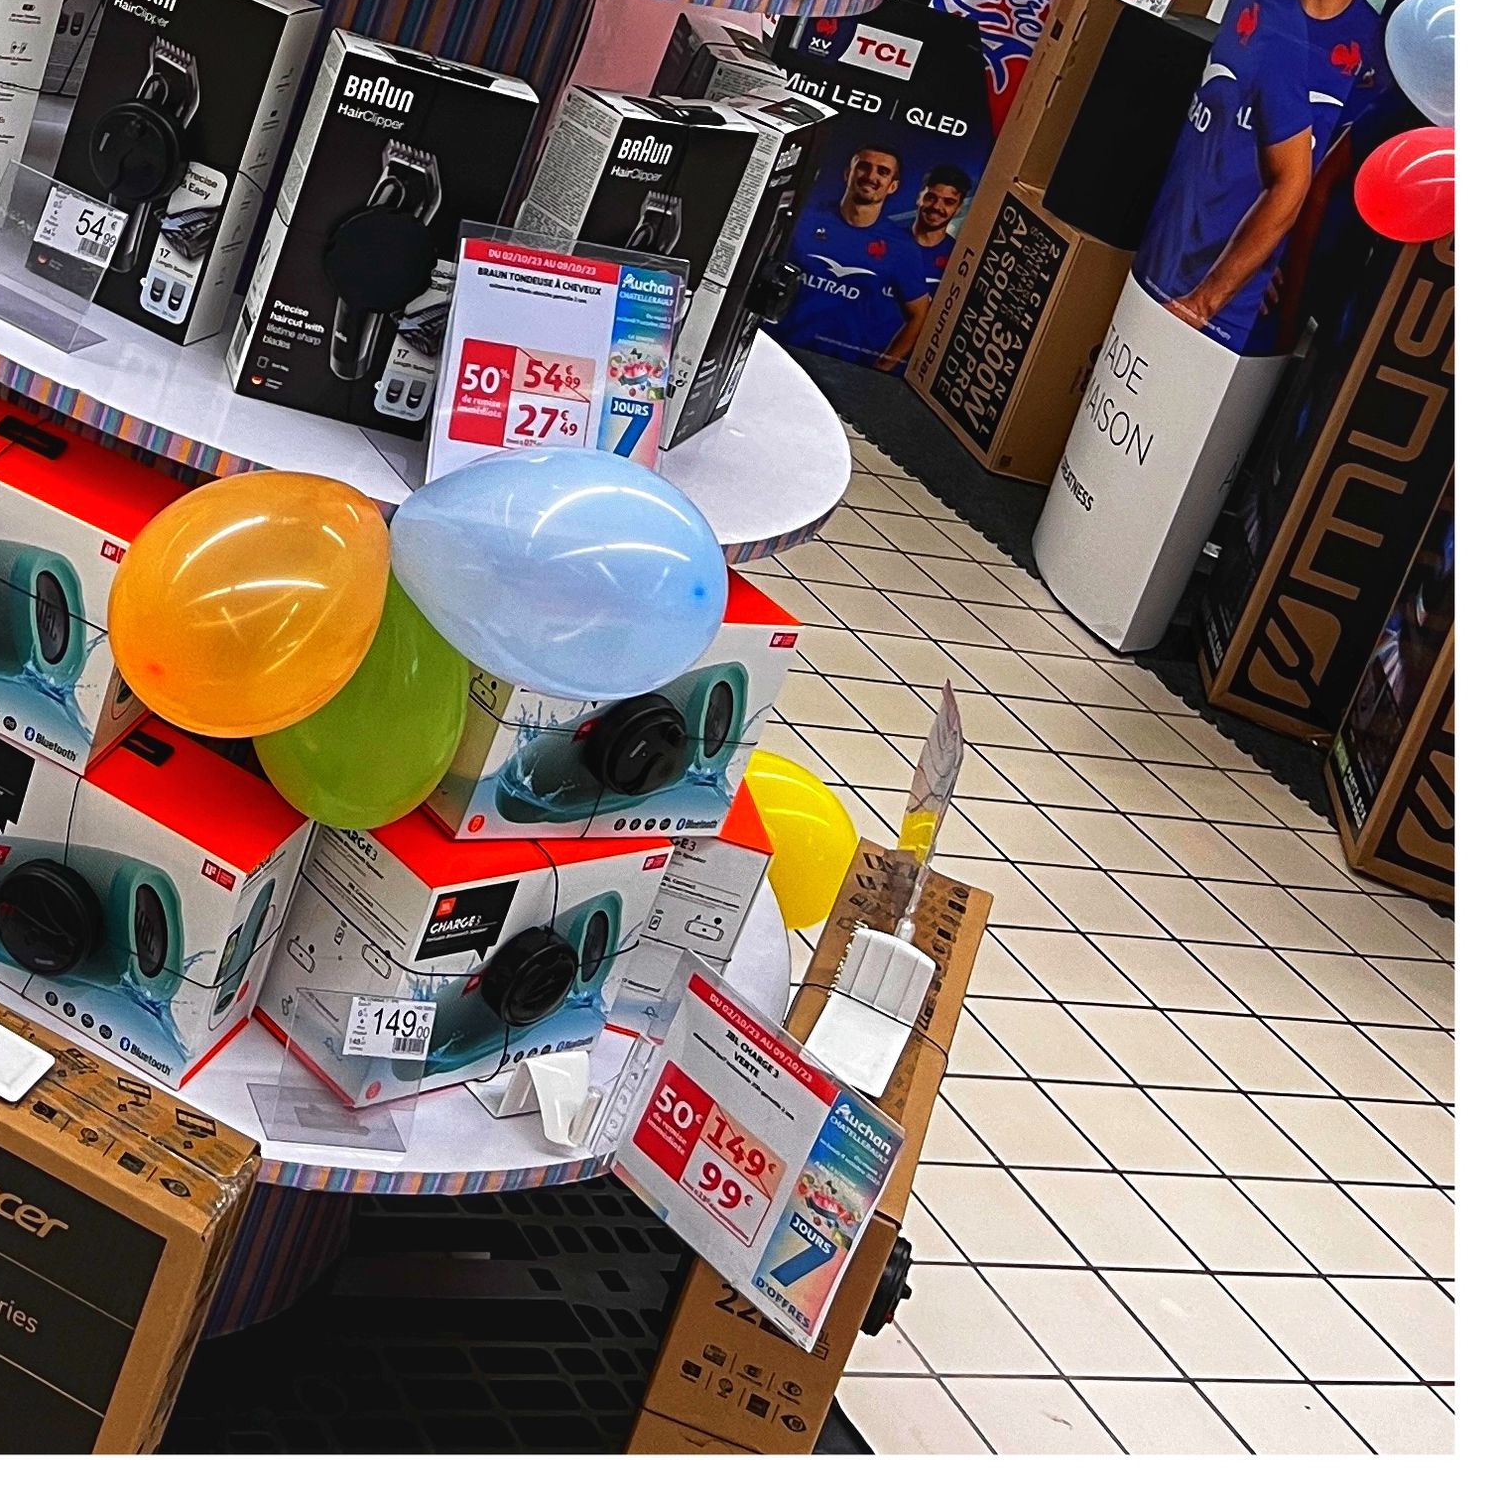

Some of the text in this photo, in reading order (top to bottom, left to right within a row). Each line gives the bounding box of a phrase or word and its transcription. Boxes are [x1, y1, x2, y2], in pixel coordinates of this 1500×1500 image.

[810, 35, 833, 51] XV
[856, 35, 912, 69] TCL
[343, 75, 414, 113] BRAUN
[784, 67, 969, 138] Mini LED QLED
[337, 103, 405, 131] HairClipper
[617, 135, 673, 166] BRAUN
[611, 165, 663, 183] HairClipper
[75, 209, 104, 238] 54
[958, 248, 976, 277] LG
[477, 267, 508, 281] BRAUN
[509, 273, 553, 289] TONDEUSE
[562, 281, 602, 296] CHEVEUX
[621, 273, 674, 296] Auchan
[799, 271, 861, 301] ALTRAD
[273, 300, 309, 318] Precise
[972, 252, 1016, 348] SOUND
[270, 311, 325, 334] haircut with
[523, 360, 564, 392] 54
[964, 322, 1012, 431] 300W
[514, 404, 559, 439] 27
[612, 401, 649, 417] JOURS
[36, 732, 78, 762] Bluetooth
[373, 1006, 417, 1039] 149
[130, 1042, 172, 1076] Bluetooth
[732, 1051, 759, 1077] VERTE
[740, 1041, 773, 1074] CHARGE
[655, 1084, 766, 1177] 50 149
[835, 1103, 892, 1155] Auchan
[699, 1161, 742, 1209] 99
[793, 1218, 832, 1255] JOURS
[756, 1277, 810, 1329] D'OFFRES
